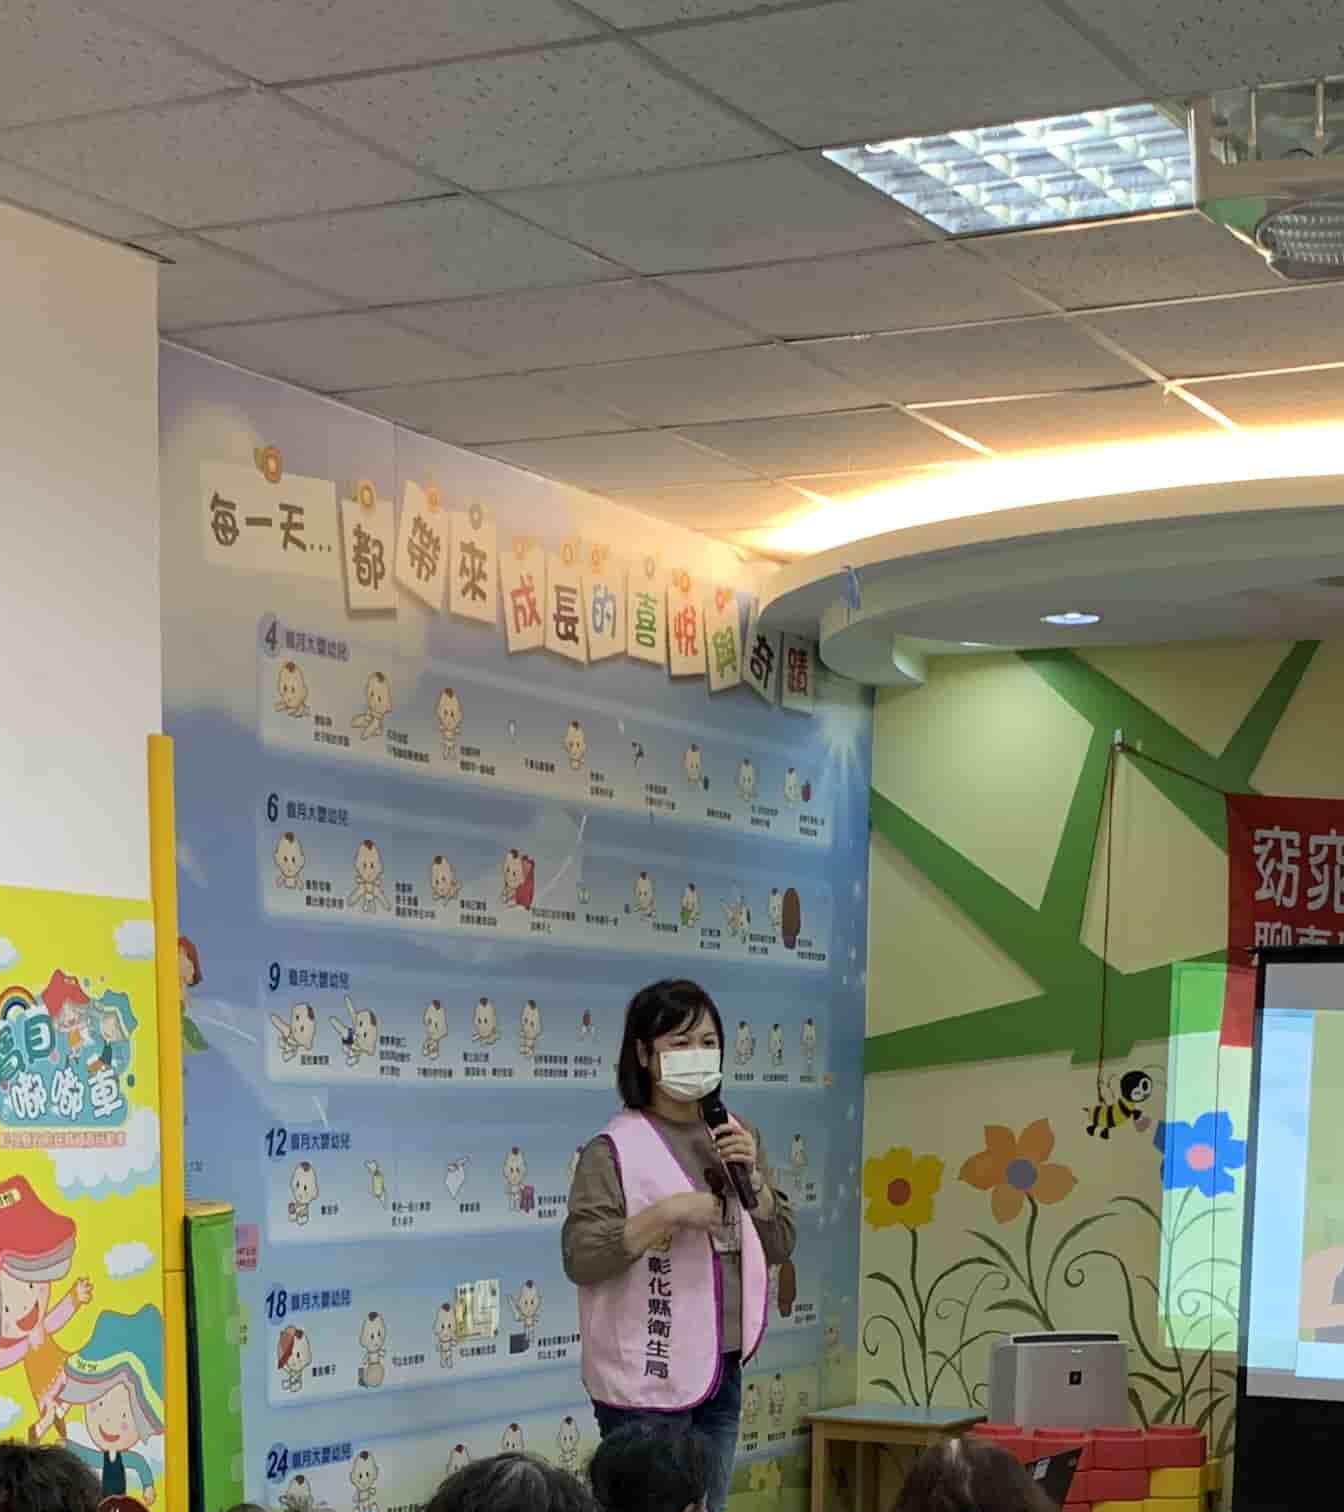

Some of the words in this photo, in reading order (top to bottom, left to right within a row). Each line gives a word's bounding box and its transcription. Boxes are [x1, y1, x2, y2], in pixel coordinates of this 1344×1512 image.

[268, 962, 281, 992] 9
[264, 1127, 288, 1158] 12
[265, 1288, 288, 1319] 18
[643, 1256, 672, 1379] 彰化縣衛生局
[267, 1449, 288, 1480] 24
